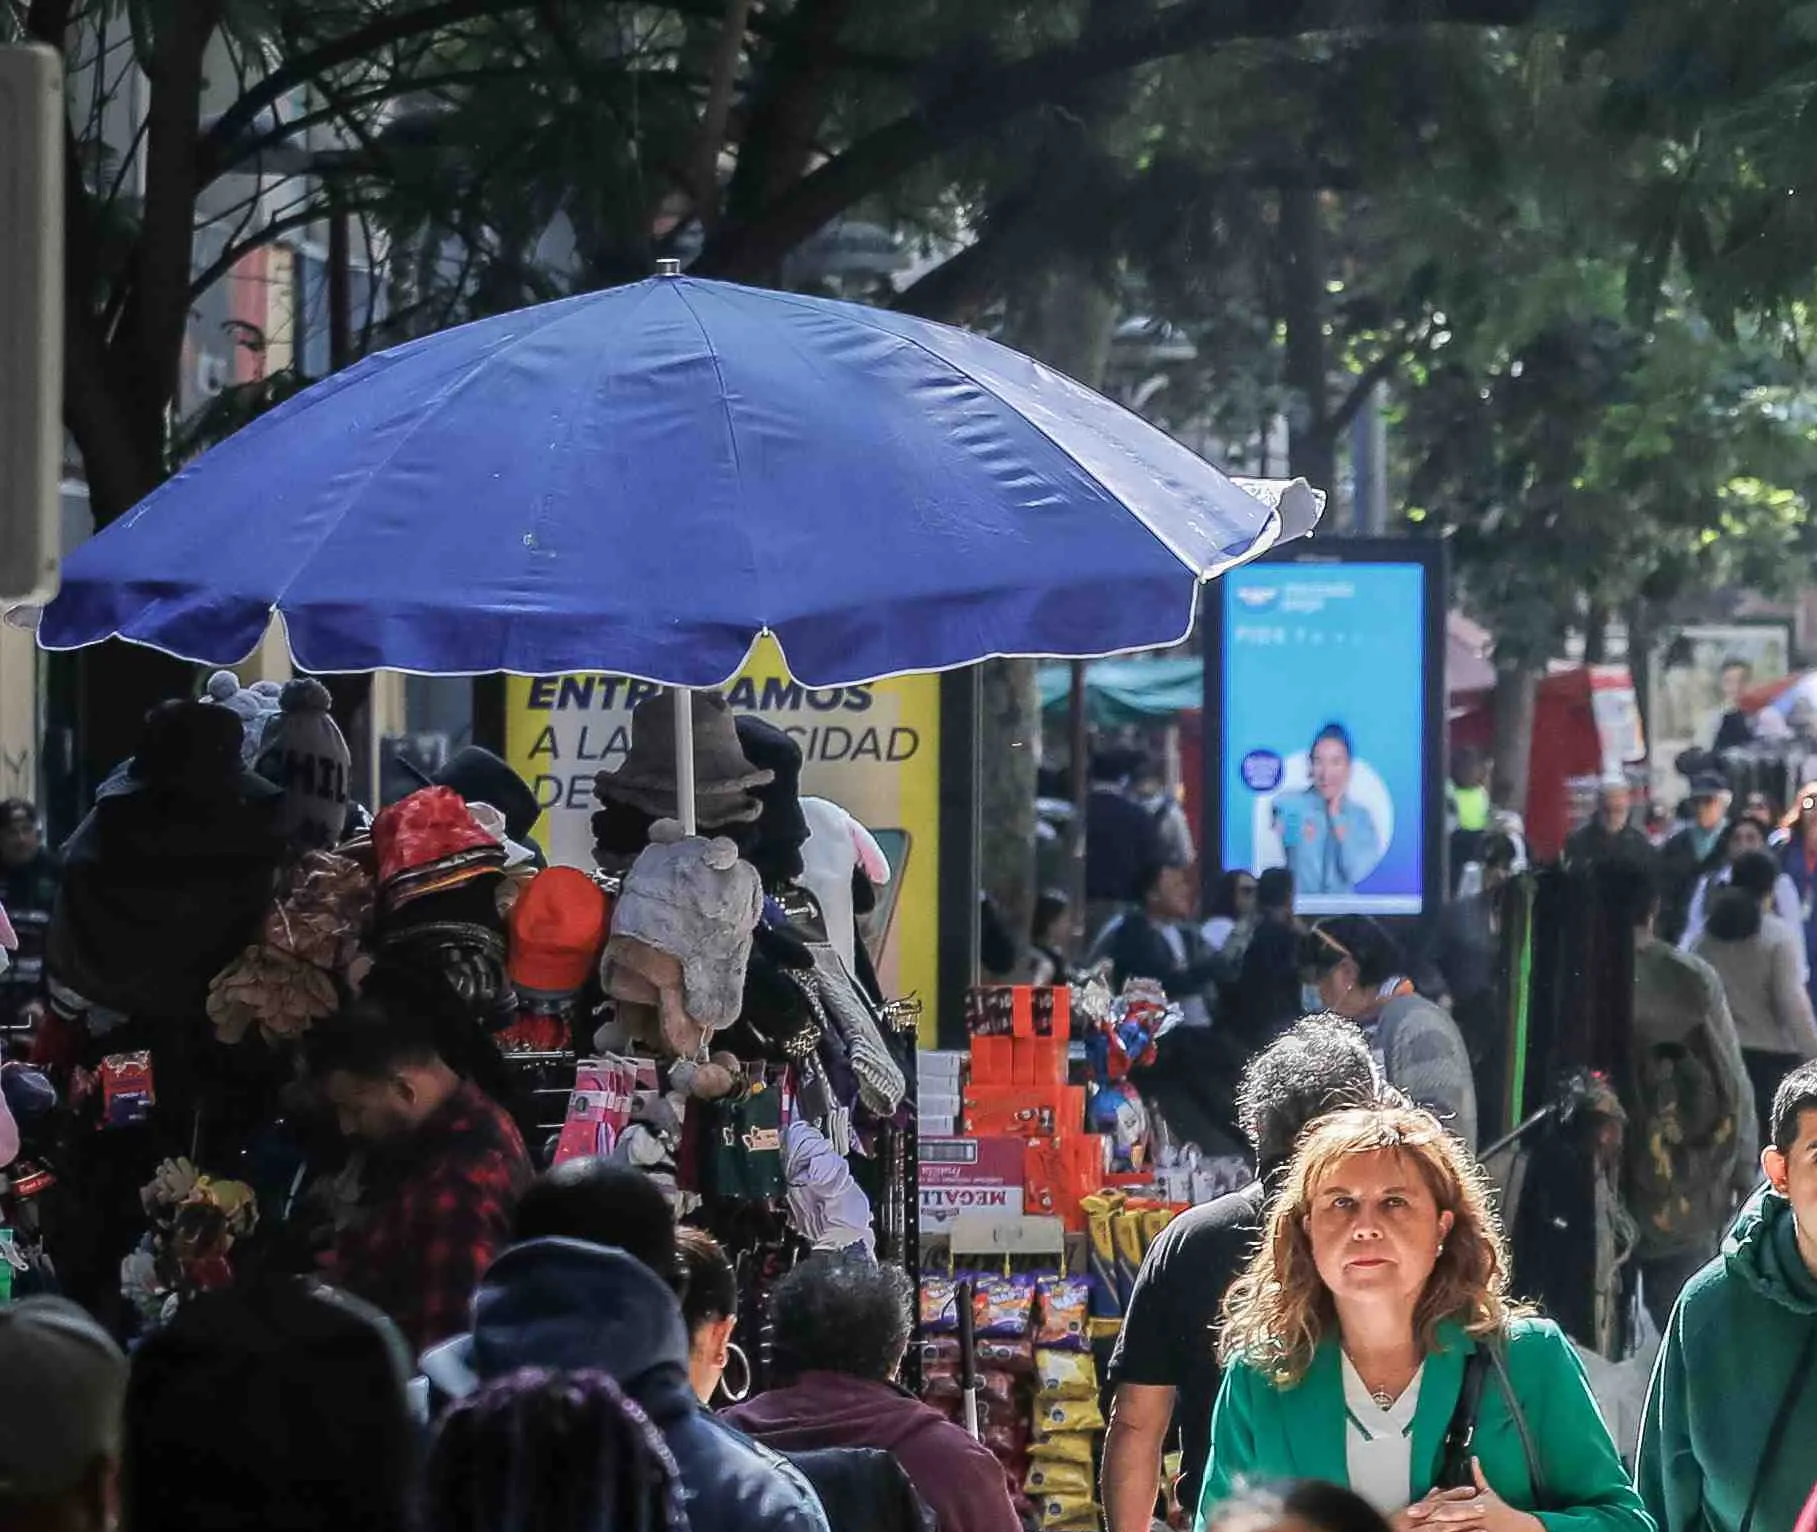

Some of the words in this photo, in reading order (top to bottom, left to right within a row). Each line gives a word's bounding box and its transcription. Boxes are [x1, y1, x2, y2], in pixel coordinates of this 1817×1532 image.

[527, 676, 874, 712] ENTRAMOS
[527, 725, 559, 760] A
[577, 725, 632, 760] LA
